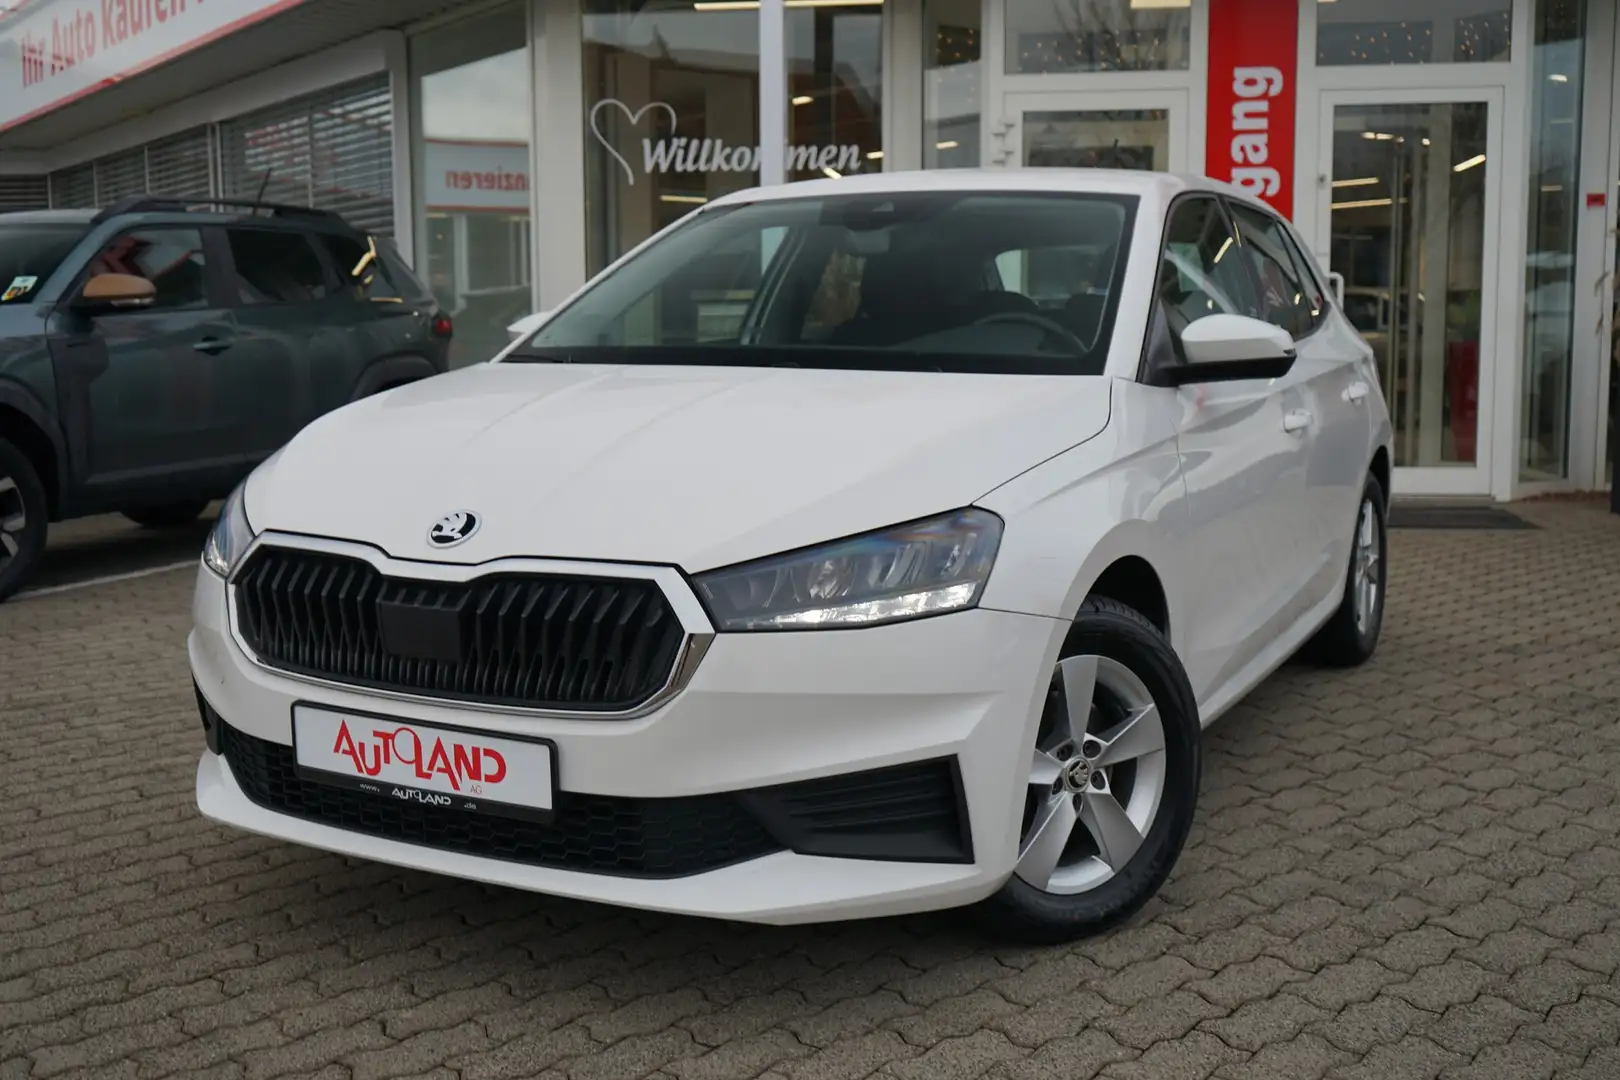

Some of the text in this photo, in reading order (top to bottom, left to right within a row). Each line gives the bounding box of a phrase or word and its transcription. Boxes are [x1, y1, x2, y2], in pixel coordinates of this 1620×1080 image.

[22, 30, 45, 89] Ihr
[51, 8, 96, 76] Auto
[642, 136, 861, 173] Willkomen
[392, 787, 451, 806] AUTOLAND
[470, 784, 483, 795] AG
